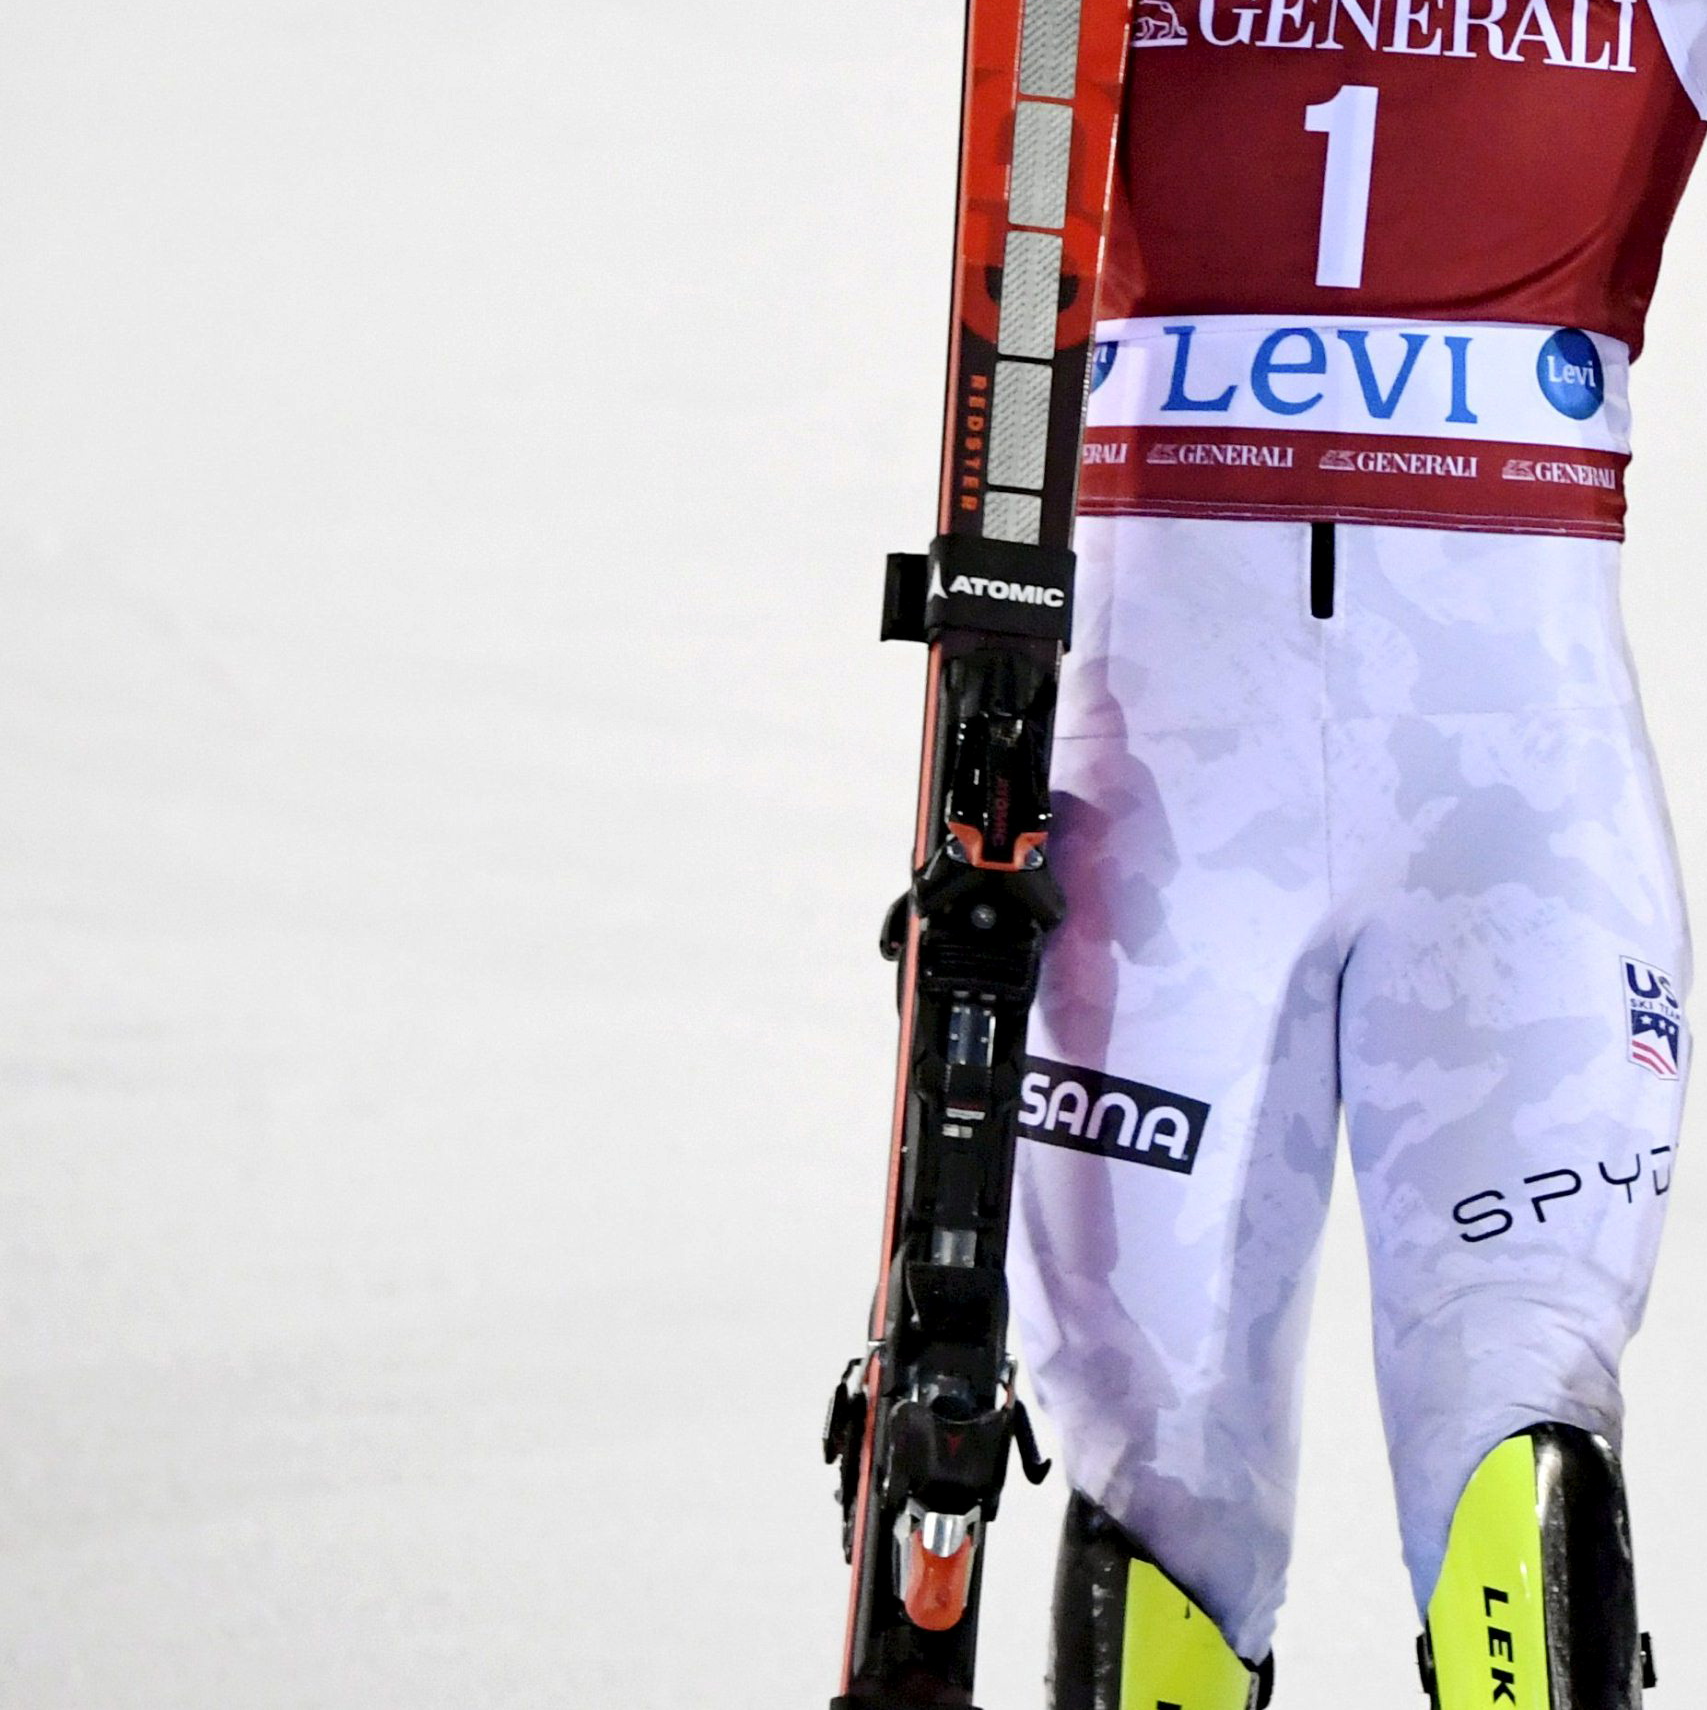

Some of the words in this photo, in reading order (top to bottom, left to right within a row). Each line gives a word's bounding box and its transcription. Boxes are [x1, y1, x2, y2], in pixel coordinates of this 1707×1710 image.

[1304, 85, 1380, 289] 1
[1160, 325, 1478, 424] Levi
[1547, 356, 1596, 389] Levi
[960, 374, 988, 514] REDSTER
[1178, 443, 1294, 469] GENERALI
[1356, 451, 1478, 479] GENERALI
[1535, 460, 1617, 491] GENERALI
[949, 575, 1065, 608] ATOMIC
[1625, 962, 1679, 1009] US
